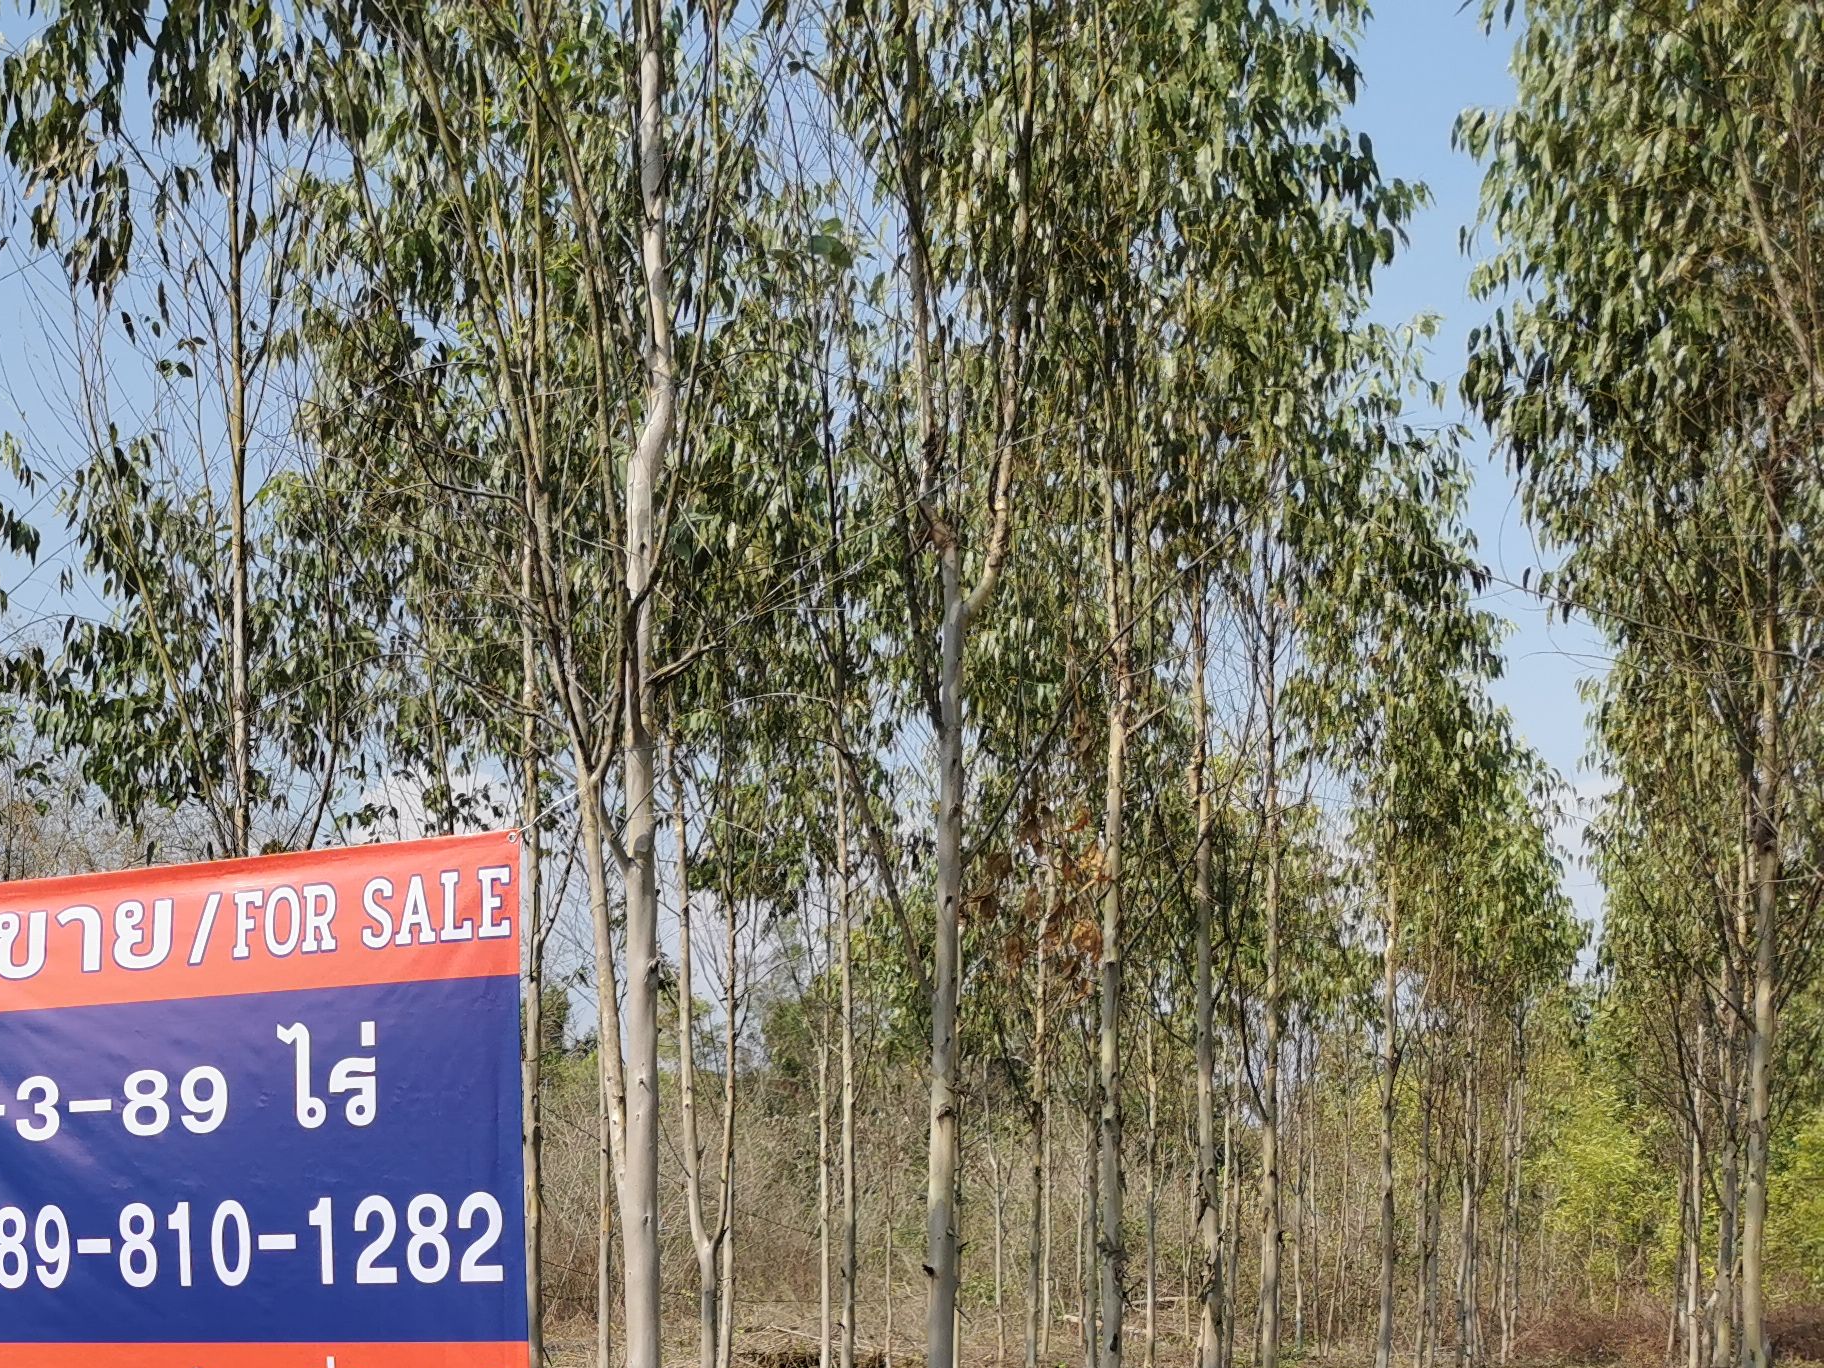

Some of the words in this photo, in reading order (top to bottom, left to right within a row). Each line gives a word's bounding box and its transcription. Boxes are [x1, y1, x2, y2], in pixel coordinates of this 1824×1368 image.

[232, 881, 337, 961] FOR
[361, 863, 512, 950] SALE
[276, 1020, 377, 1129] ไร่
